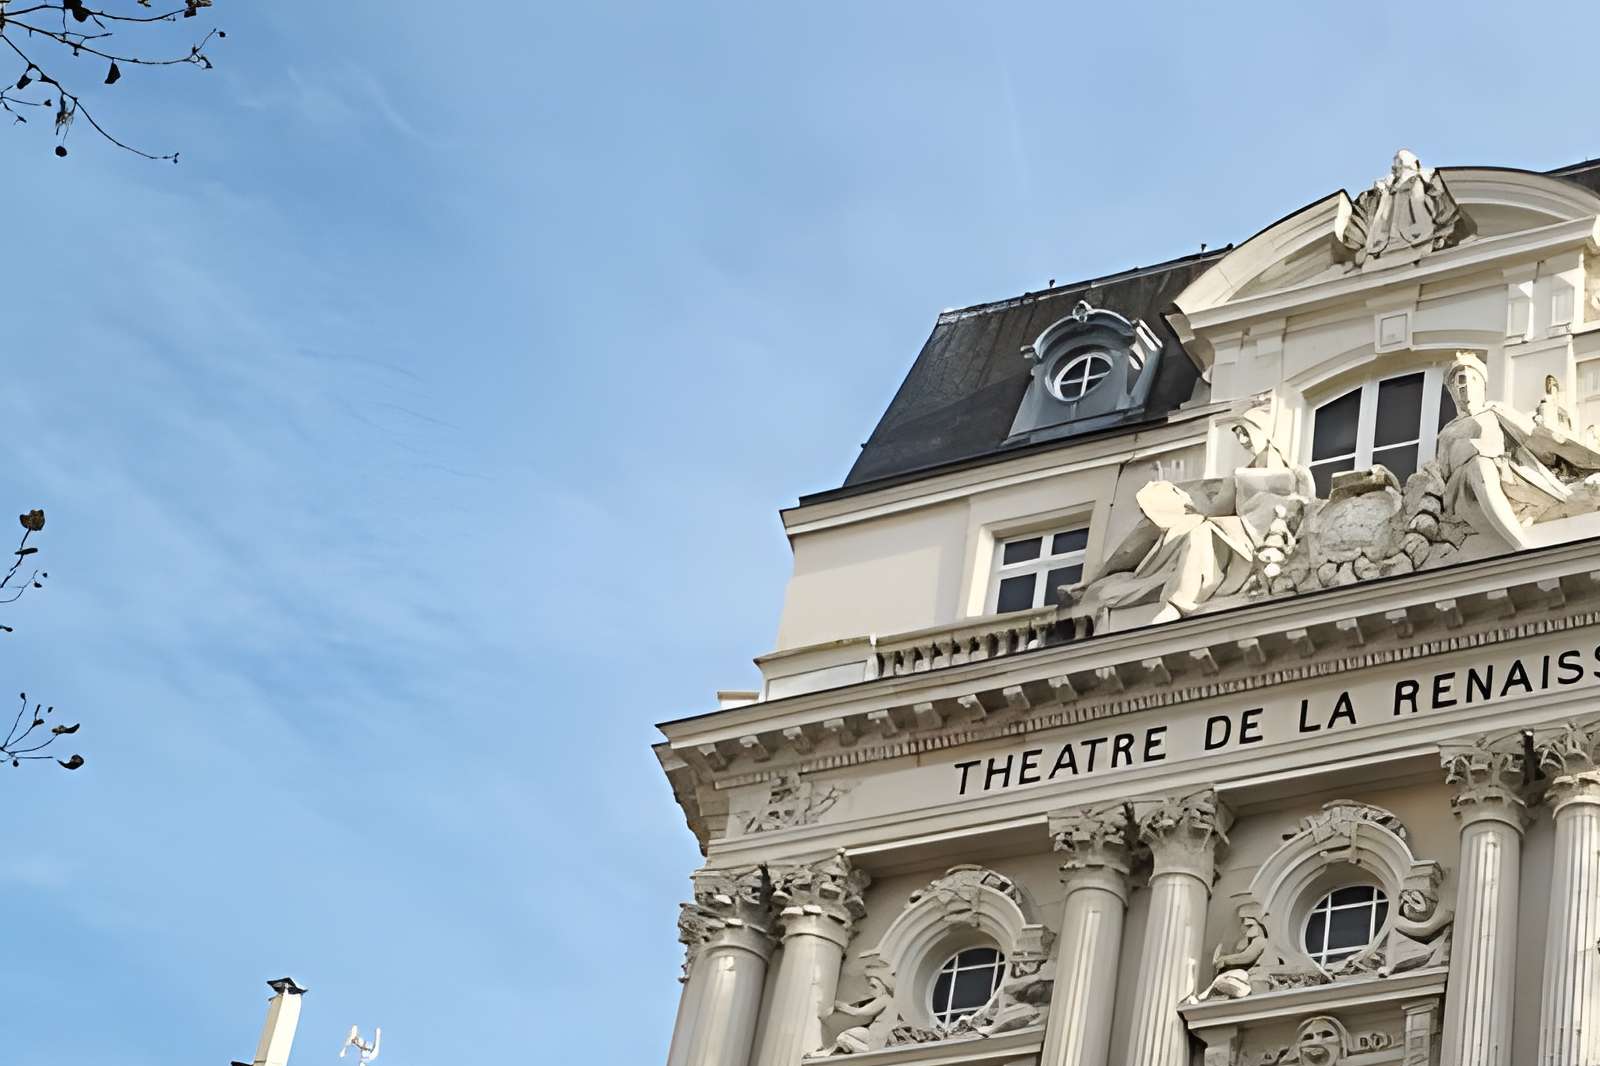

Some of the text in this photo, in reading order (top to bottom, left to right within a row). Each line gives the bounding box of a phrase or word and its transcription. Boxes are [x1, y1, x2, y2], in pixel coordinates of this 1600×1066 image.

[955, 725, 1168, 795] THEATRE
[1204, 707, 1264, 751] DE
[1299, 691, 1357, 733] LA
